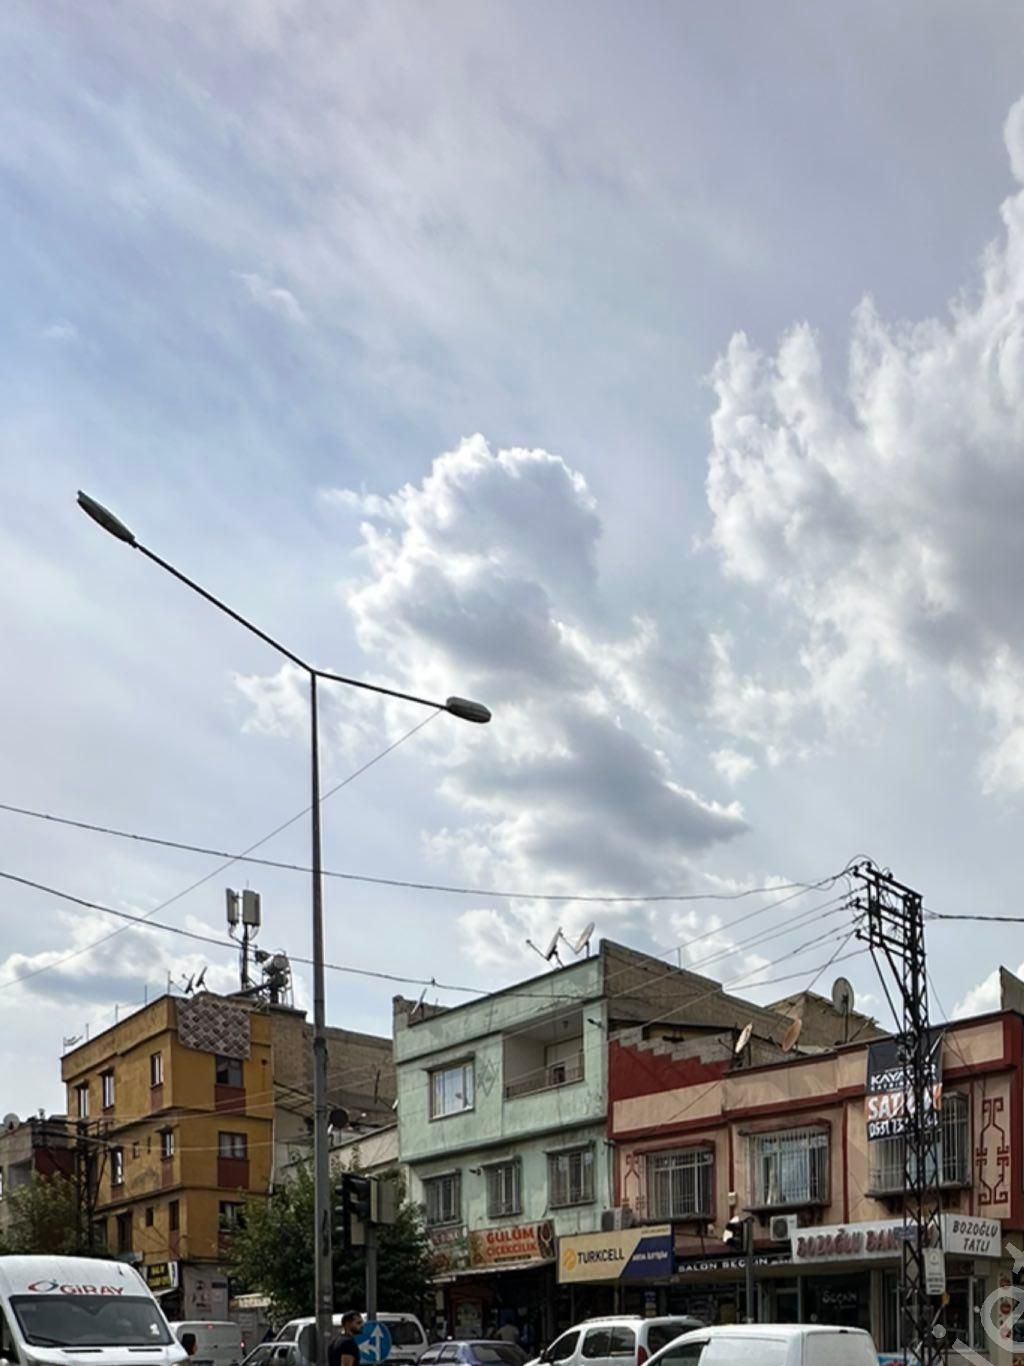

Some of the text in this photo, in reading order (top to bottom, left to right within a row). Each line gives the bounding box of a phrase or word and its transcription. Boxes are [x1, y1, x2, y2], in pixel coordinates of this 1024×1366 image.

[953, 1220, 999, 1238] BOZOĞLU
[963, 1238, 991, 1252] TATLI
[577, 1248, 625, 1264] TURKCELL
[678, 1262, 717, 1273] SALON
